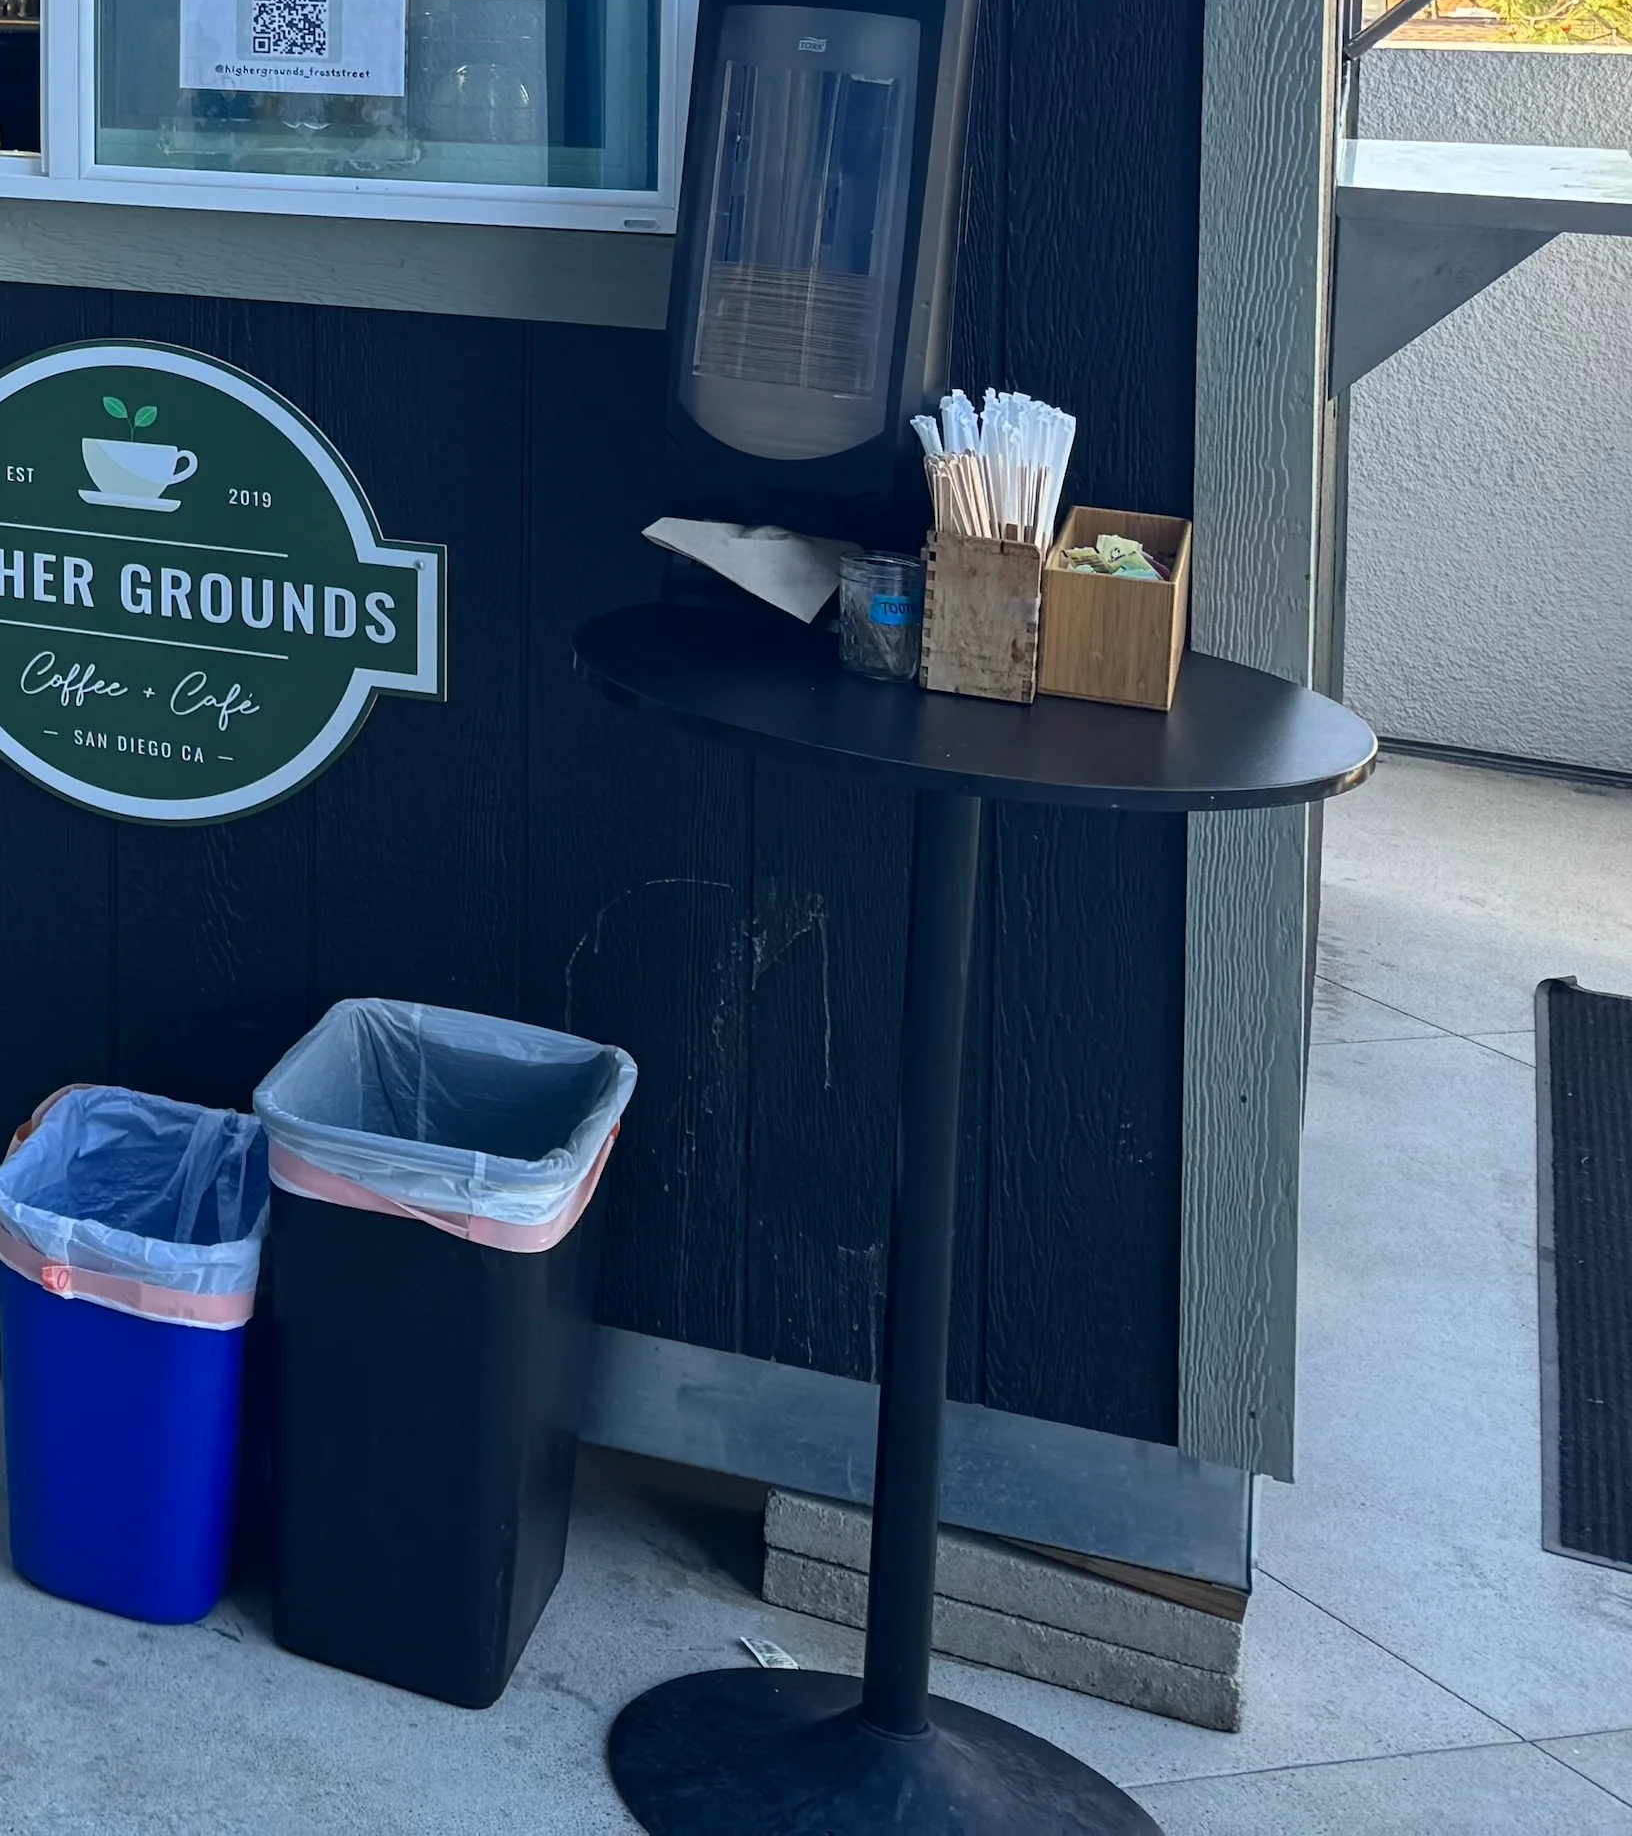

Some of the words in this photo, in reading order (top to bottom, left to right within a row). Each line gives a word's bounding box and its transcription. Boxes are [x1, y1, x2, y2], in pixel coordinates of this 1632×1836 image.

[7, 466, 34, 483] EST
[229, 489, 272, 508] 2019
[120, 563, 396, 644] GROUNDS
[20, 650, 129, 707] Coffee
[170, 671, 261, 732] Café
[74, 729, 107, 749] SAN
[117, 735, 172, 758] DIEGO
[181, 745, 204, 764] CA
